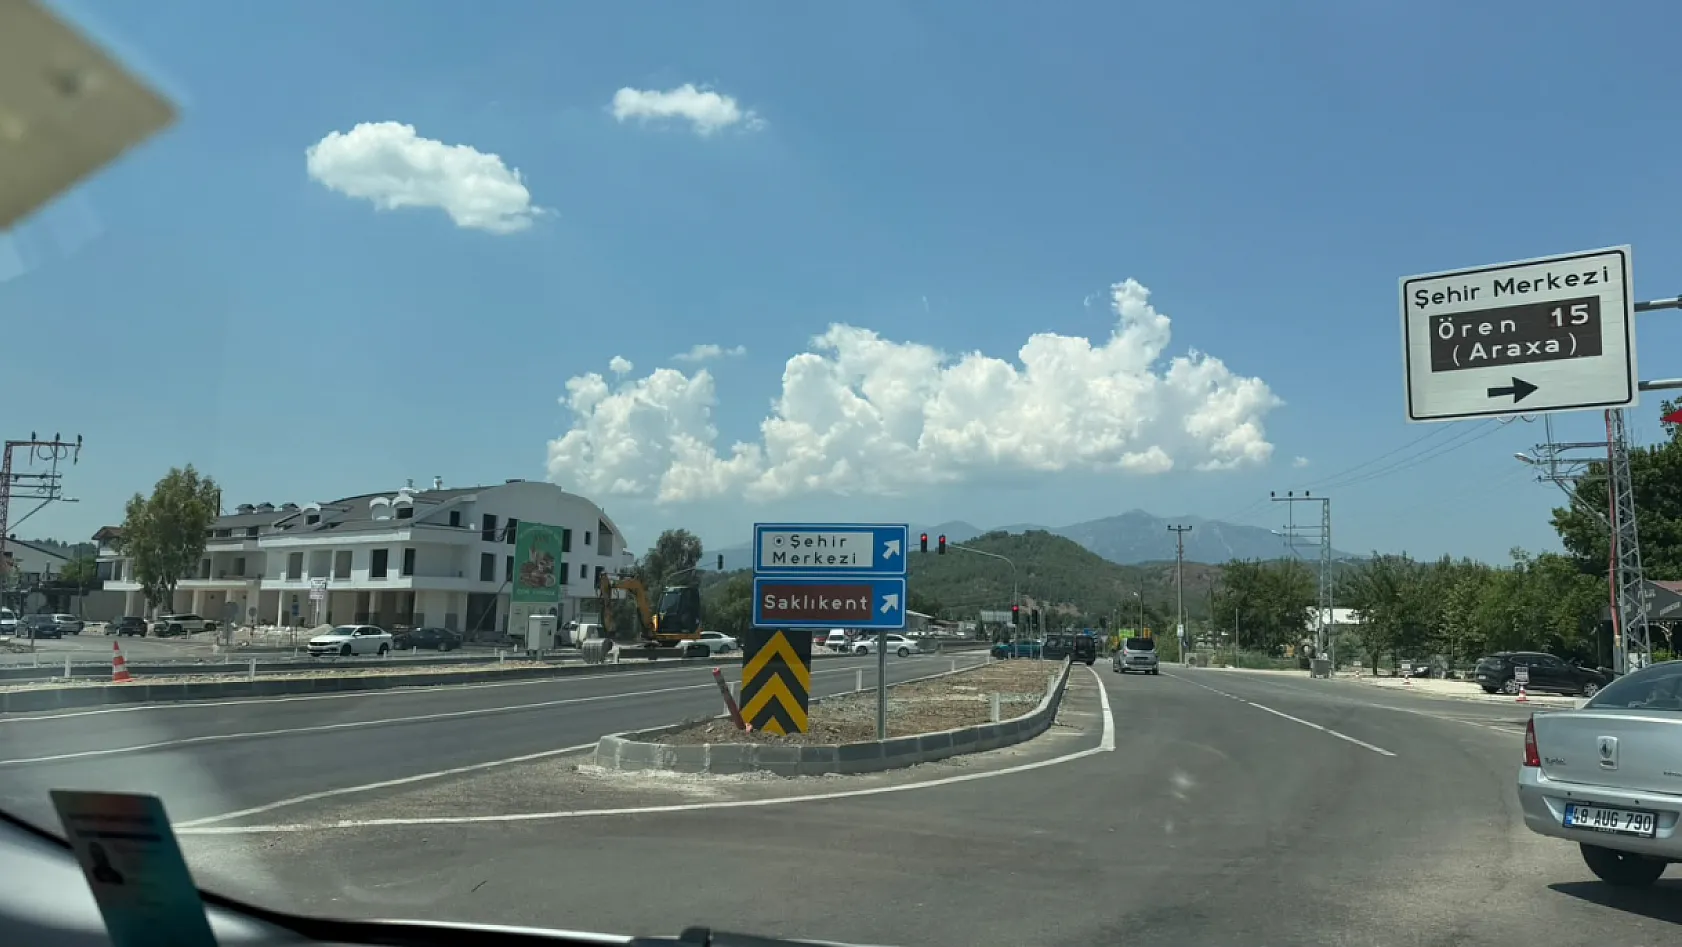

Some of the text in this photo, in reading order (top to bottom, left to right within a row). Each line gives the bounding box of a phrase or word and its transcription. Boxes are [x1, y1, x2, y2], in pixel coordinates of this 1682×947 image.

[1414, 266, 1610, 309] Şehir Merkezi
[1438, 304, 1589, 340] Ören 15
[790, 534, 847, 549] Şehir
[772, 552, 856, 564] Merkezi
[764, 594, 868, 610] Saklıkent
[1573, 807, 1651, 832] 48 AUG 790
